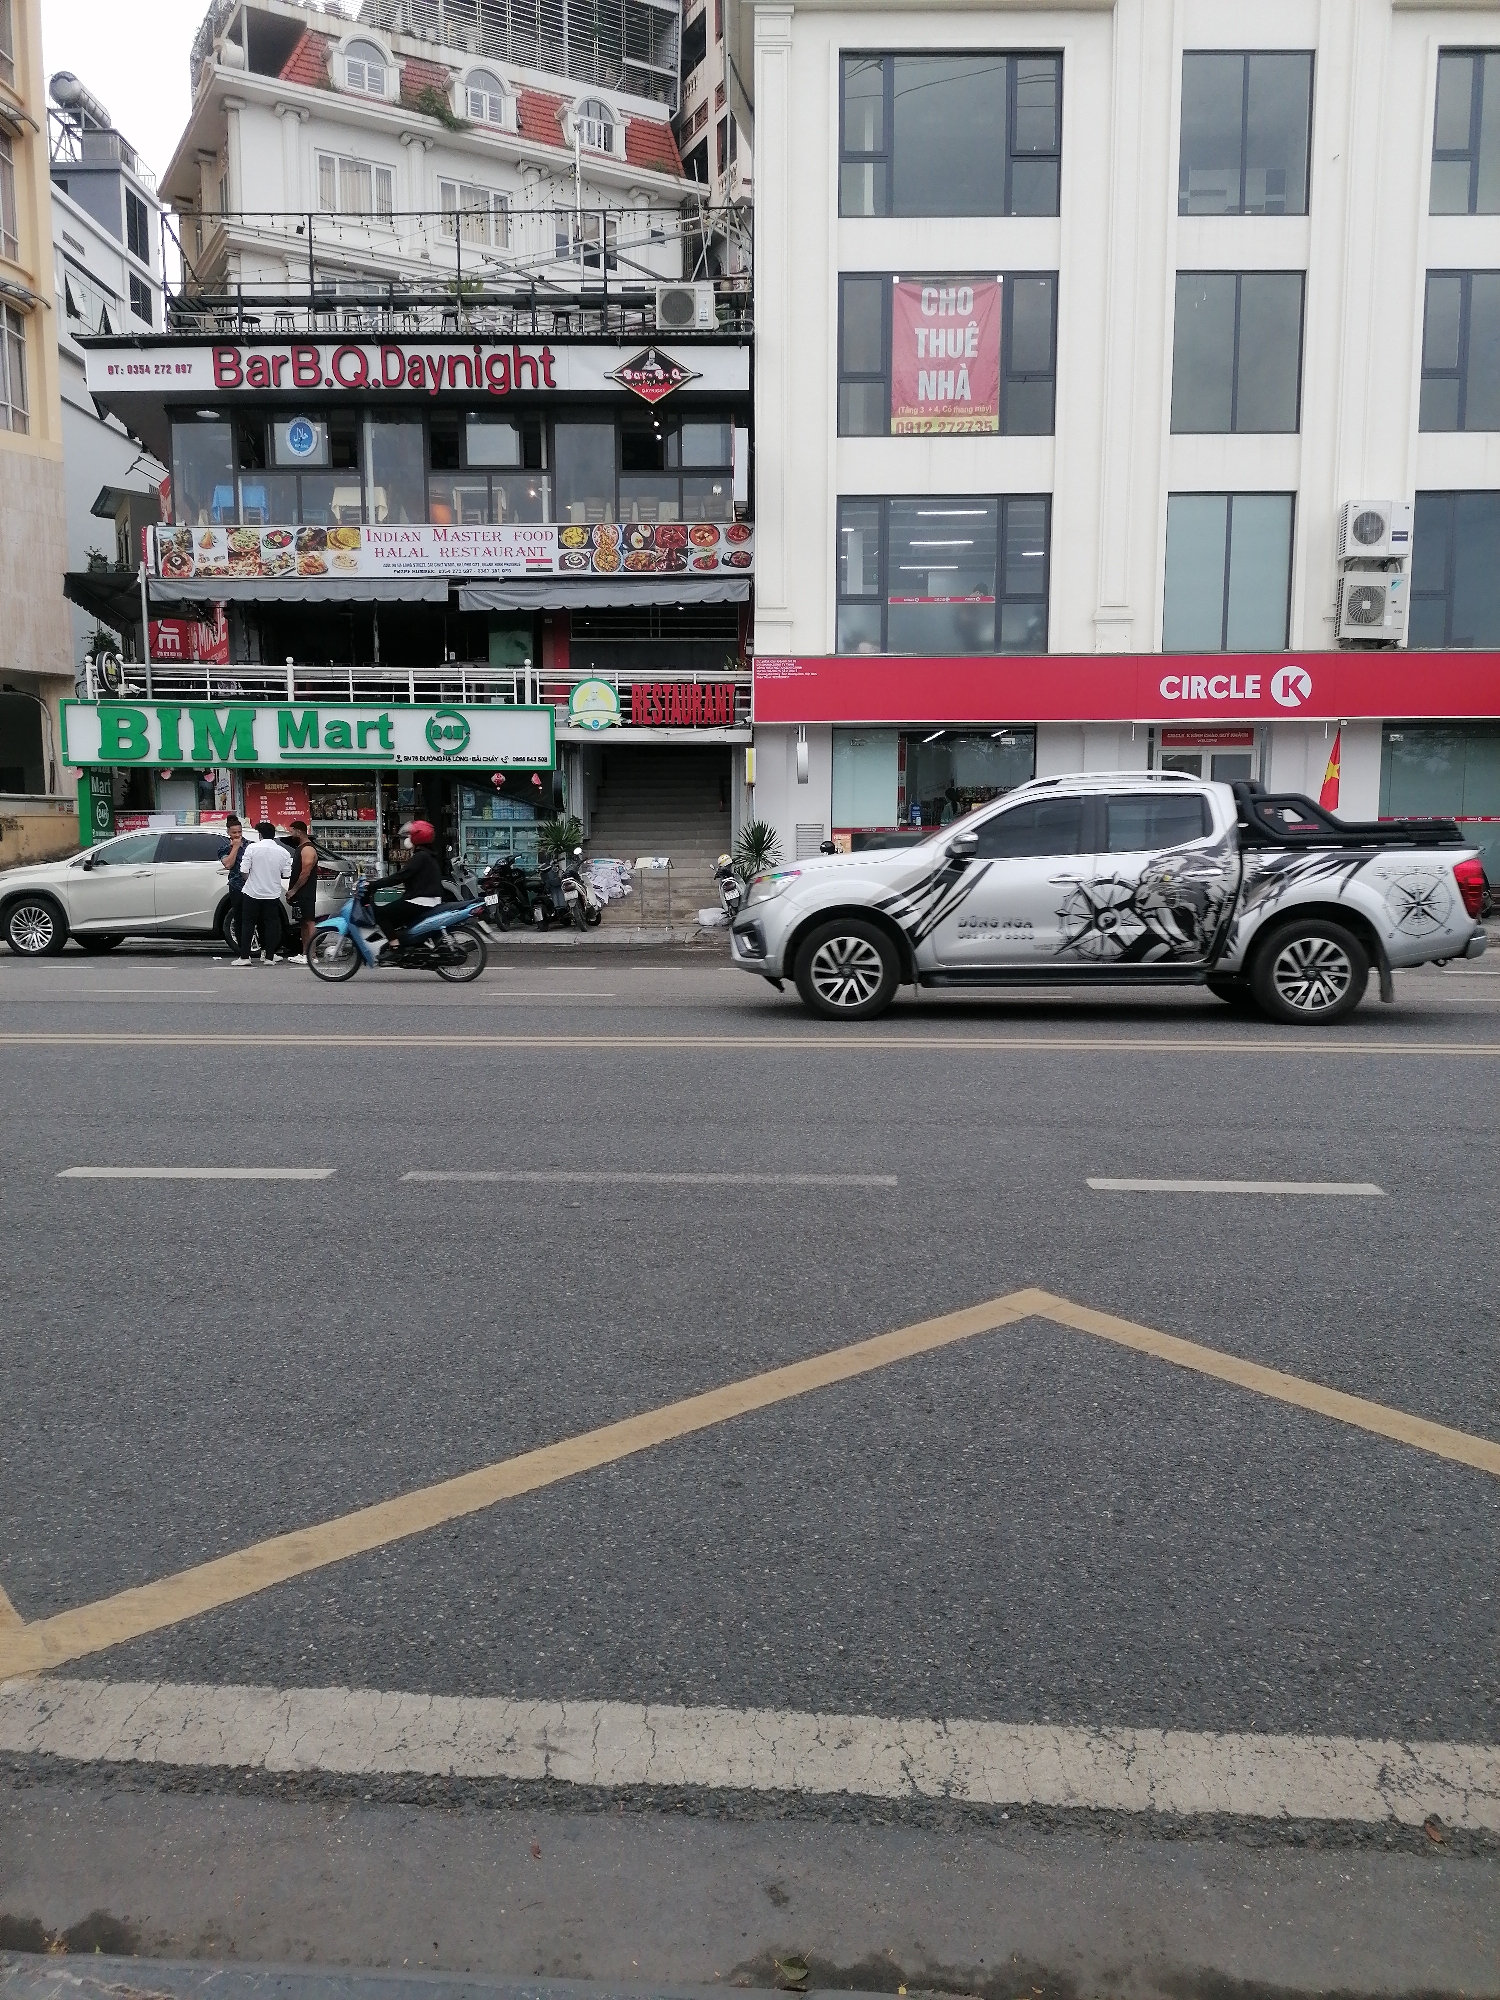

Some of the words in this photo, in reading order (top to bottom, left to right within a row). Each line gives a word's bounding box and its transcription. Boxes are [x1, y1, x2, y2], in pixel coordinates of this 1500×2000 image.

[922, 286, 973, 316] CHO
[915, 321, 979, 358] THUÊ
[127, 364, 150, 375] 0354
[154, 364, 172, 375] 272
[918, 363, 971, 400] NHÀ
[954, 406, 973, 415] thang
[896, 422, 932, 434] 0912
[375, 547, 429, 558] HALAL
[440, 546, 546, 558] RESTAURANT
[1160, 675, 1261, 700] CIRCLE
[1276, 669, 1312, 706] K
[632, 683, 735, 725] RESTAURANT
[97, 707, 258, 760] BIM
[277, 711, 395, 749] Mart
[91, 776, 111, 794] Mart
